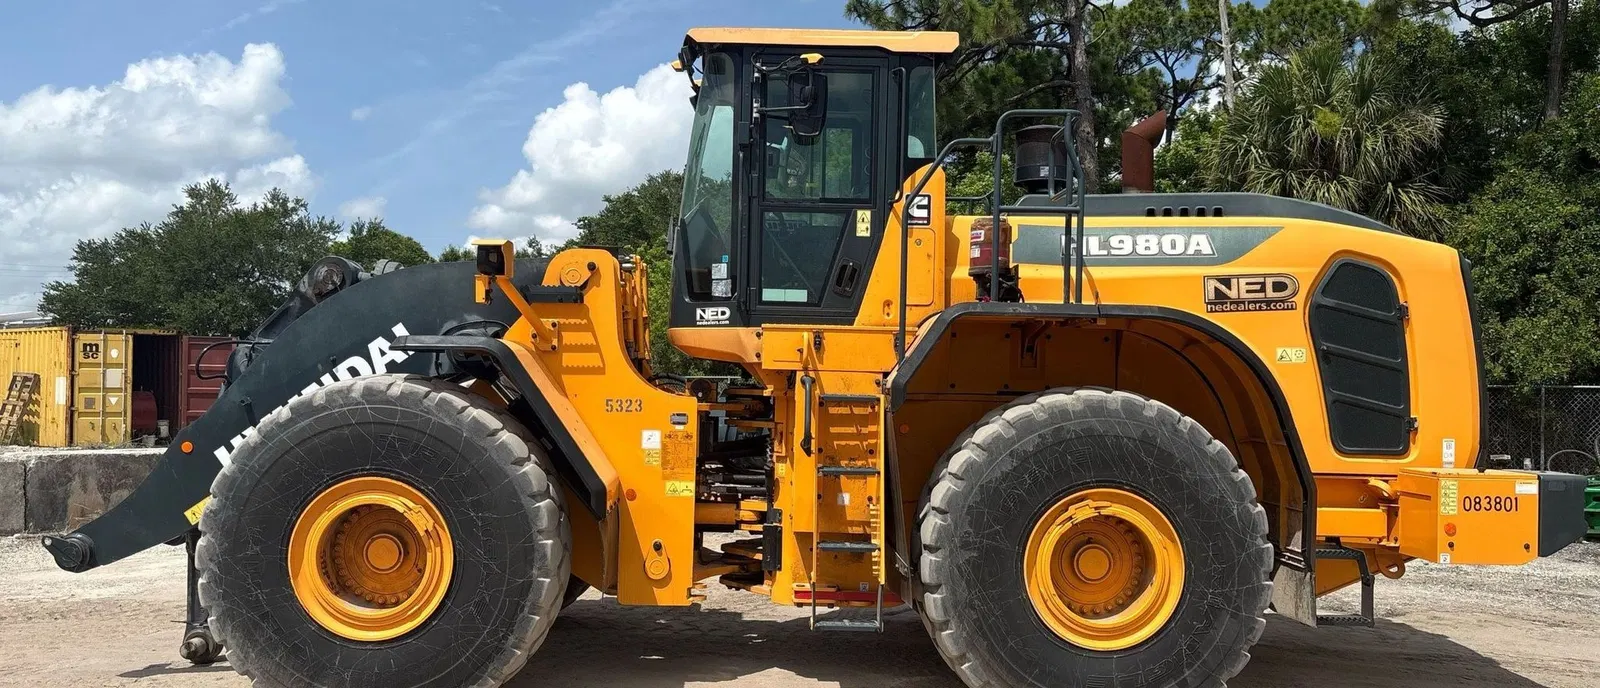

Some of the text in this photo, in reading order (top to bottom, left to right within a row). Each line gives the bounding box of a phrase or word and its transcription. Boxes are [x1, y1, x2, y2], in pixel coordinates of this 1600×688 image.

[1206, 276, 1298, 300] NED
[696, 307, 731, 321] NED
[1207, 301, 1296, 312] nedealers.com
[605, 398, 643, 413] 5323
[1462, 495, 1519, 512] 083801
